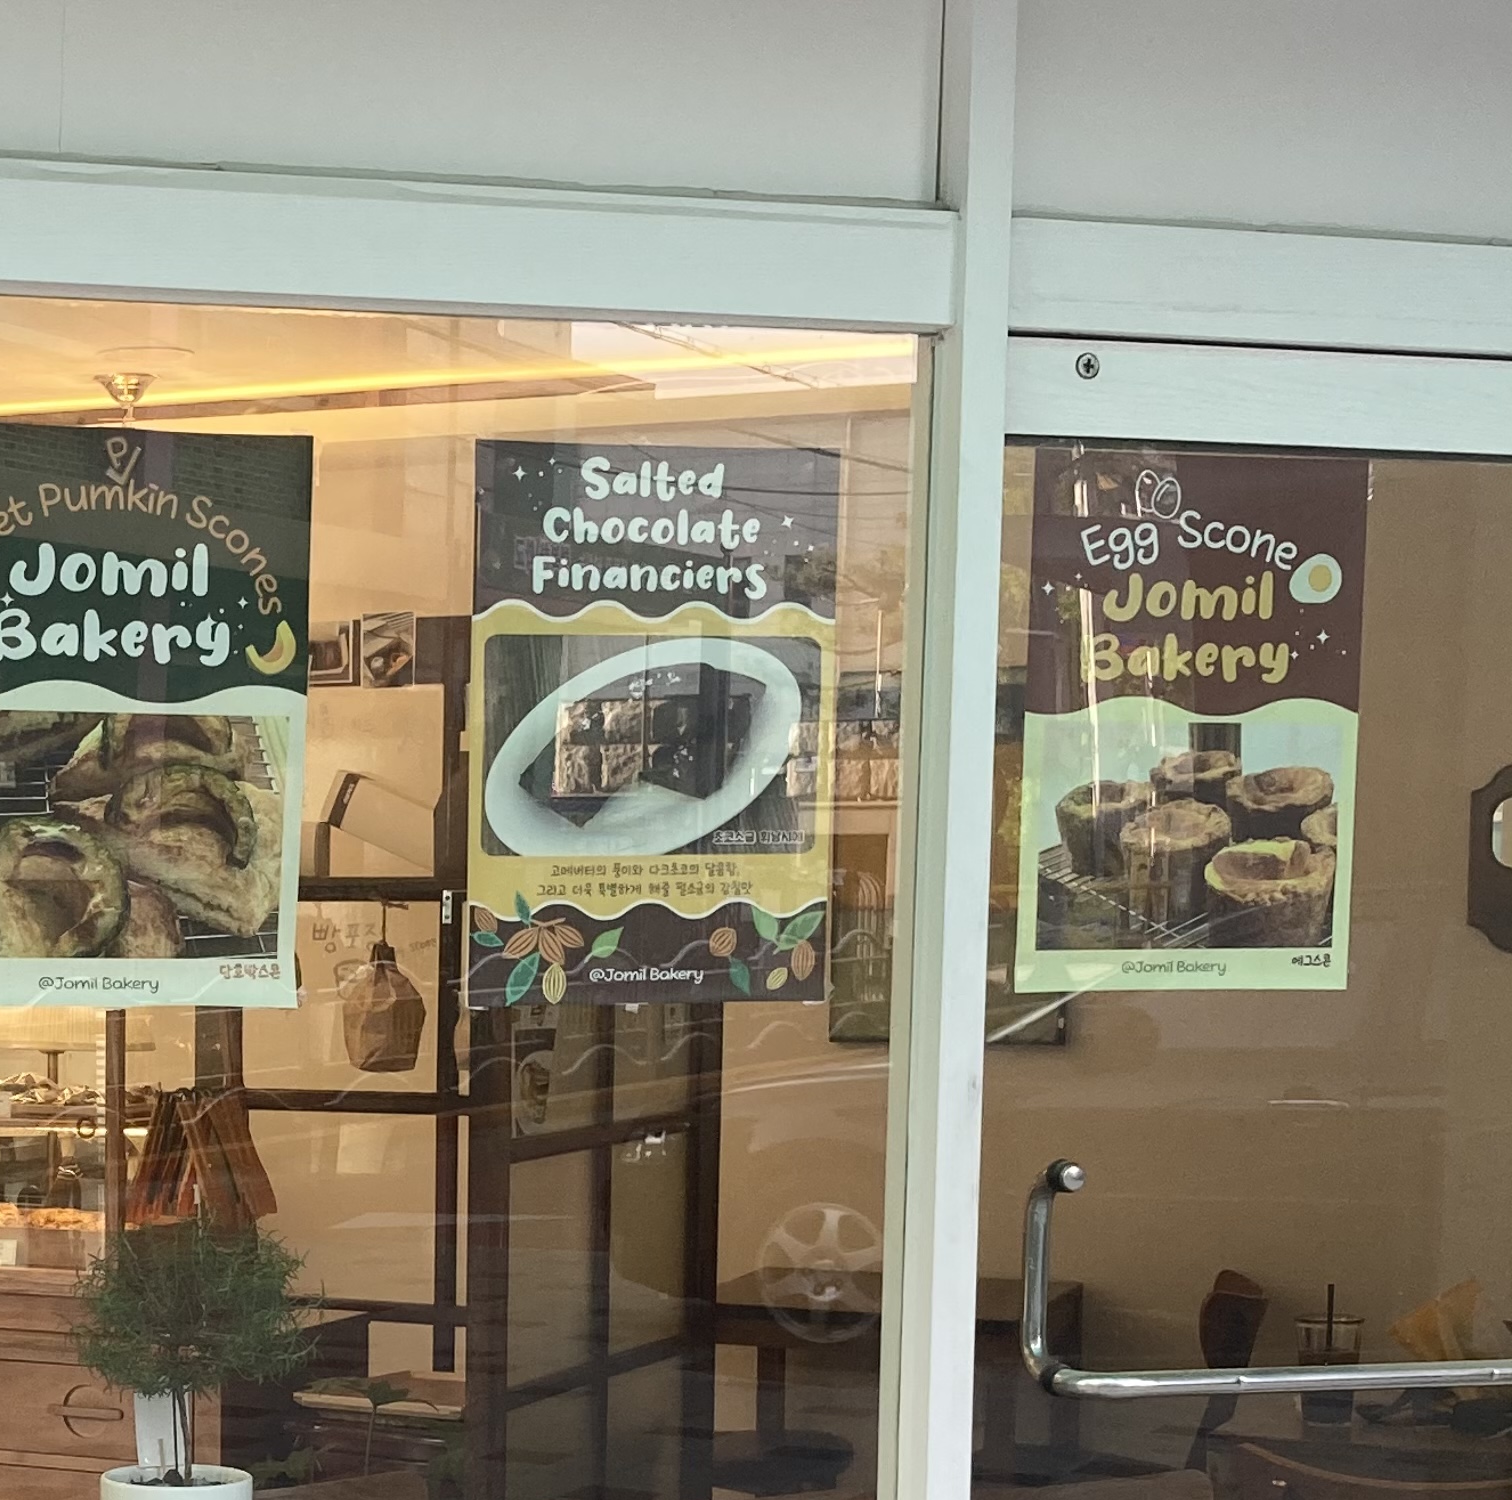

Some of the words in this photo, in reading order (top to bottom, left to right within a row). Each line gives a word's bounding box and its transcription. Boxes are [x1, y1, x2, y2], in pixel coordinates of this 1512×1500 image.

[581, 456, 725, 501] Salted
[38, 479, 178, 520] Pumkin
[186, 494, 282, 616] Scones
[542, 507, 761, 549] Chocolate
[1080, 521, 1160, 570] Egg
[1177, 510, 1298, 570] Scone
[9, 542, 208, 597] Jomil
[531, 555, 767, 600] Financiers
[1103, 570, 1274, 622] Jomil
[1080, 632, 1289, 684] Bakery
[536, 884, 566, 896] 그리고
[589, 968, 647, 982] @Jomil
[649, 967, 703, 985] Bakery
[1121, 961, 1173, 974] @Jomil
[1177, 961, 1226, 976] Bakery
[1291, 953, 1331, 968] 에그스콘
[38, 976, 99, 991] @Jomil
[102, 976, 160, 994] Bakery
